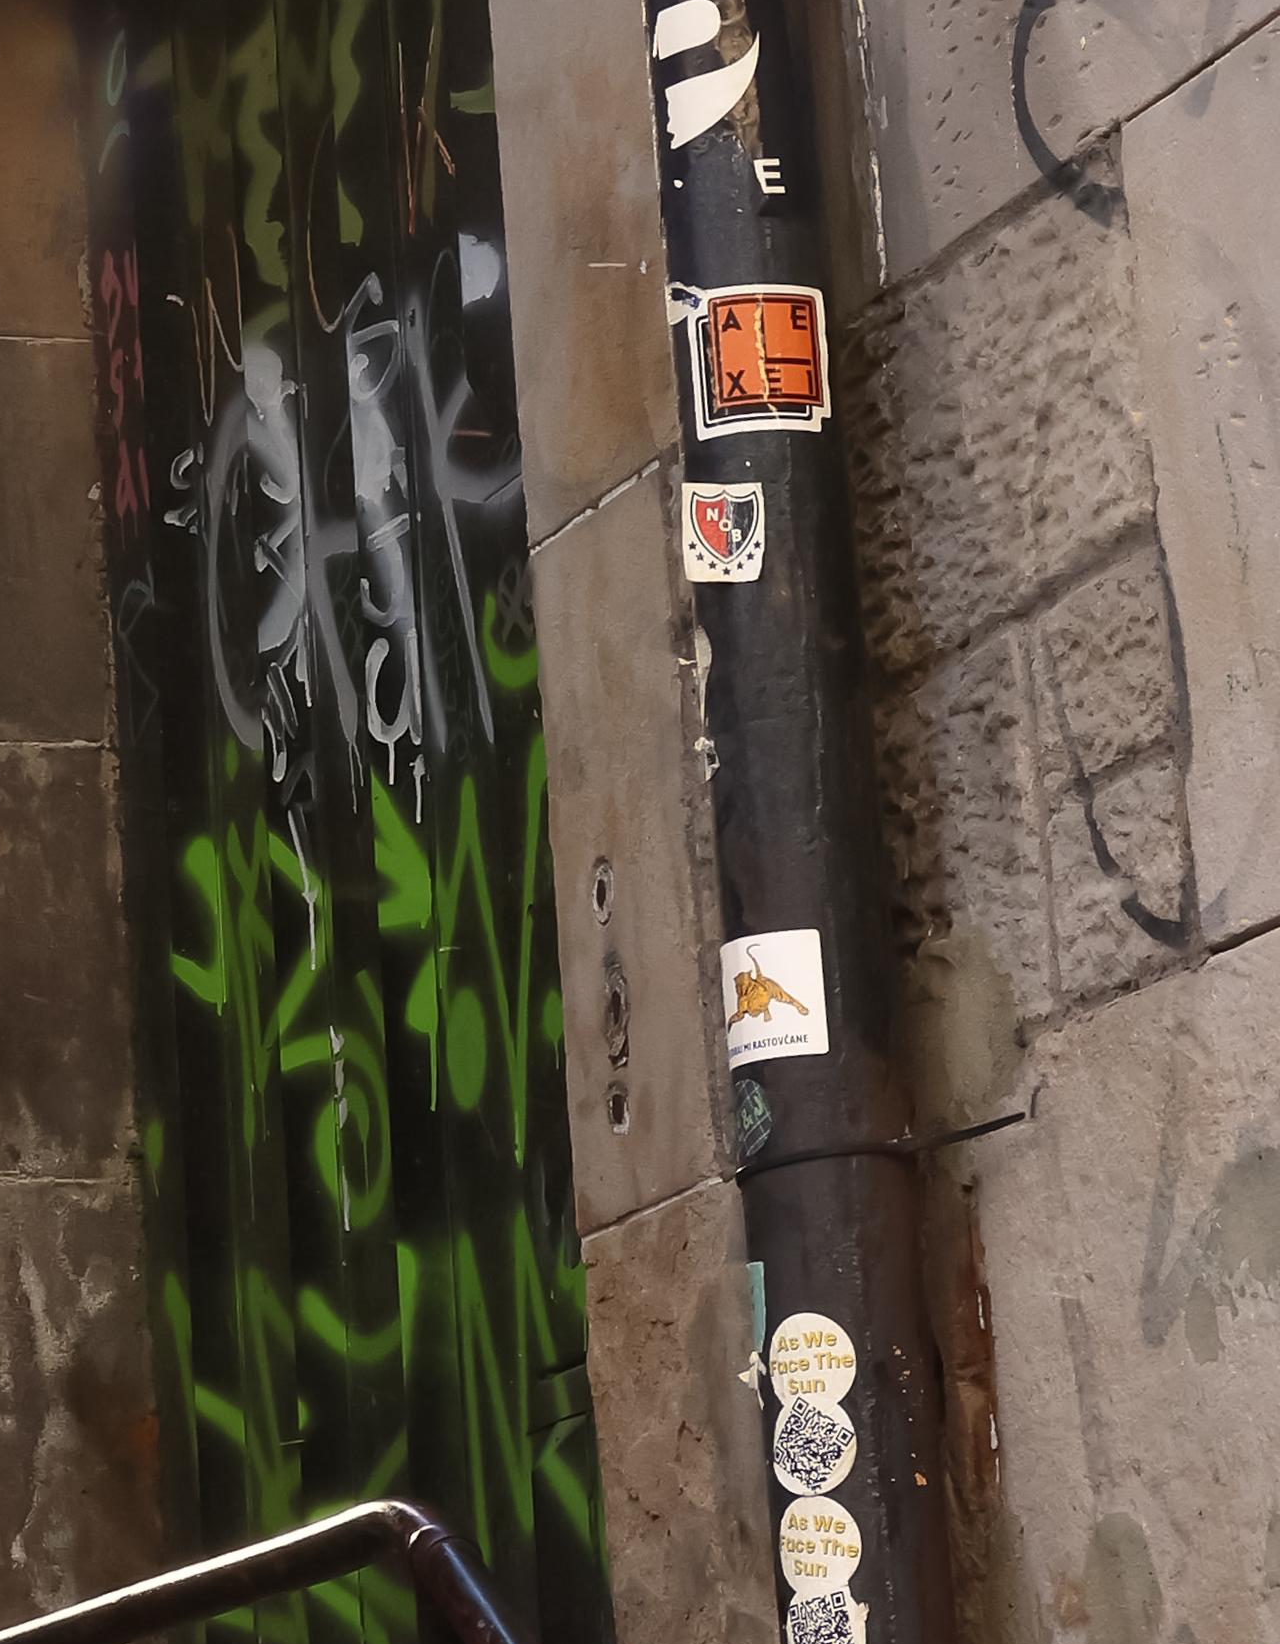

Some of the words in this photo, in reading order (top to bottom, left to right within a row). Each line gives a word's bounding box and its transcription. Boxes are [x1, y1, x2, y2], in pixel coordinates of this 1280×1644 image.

[752, 1034, 809, 1050] RASTOVČANE
[777, 1336, 799, 1353] As
[802, 1331, 837, 1348] We
[771, 1358, 810, 1377] Face
[813, 1352, 854, 1370] The
[788, 1378, 826, 1395] Sun
[788, 1513, 808, 1531] As
[812, 1514, 846, 1534] We
[820, 1537, 859, 1558] The
[794, 1559, 828, 1577] Sun
